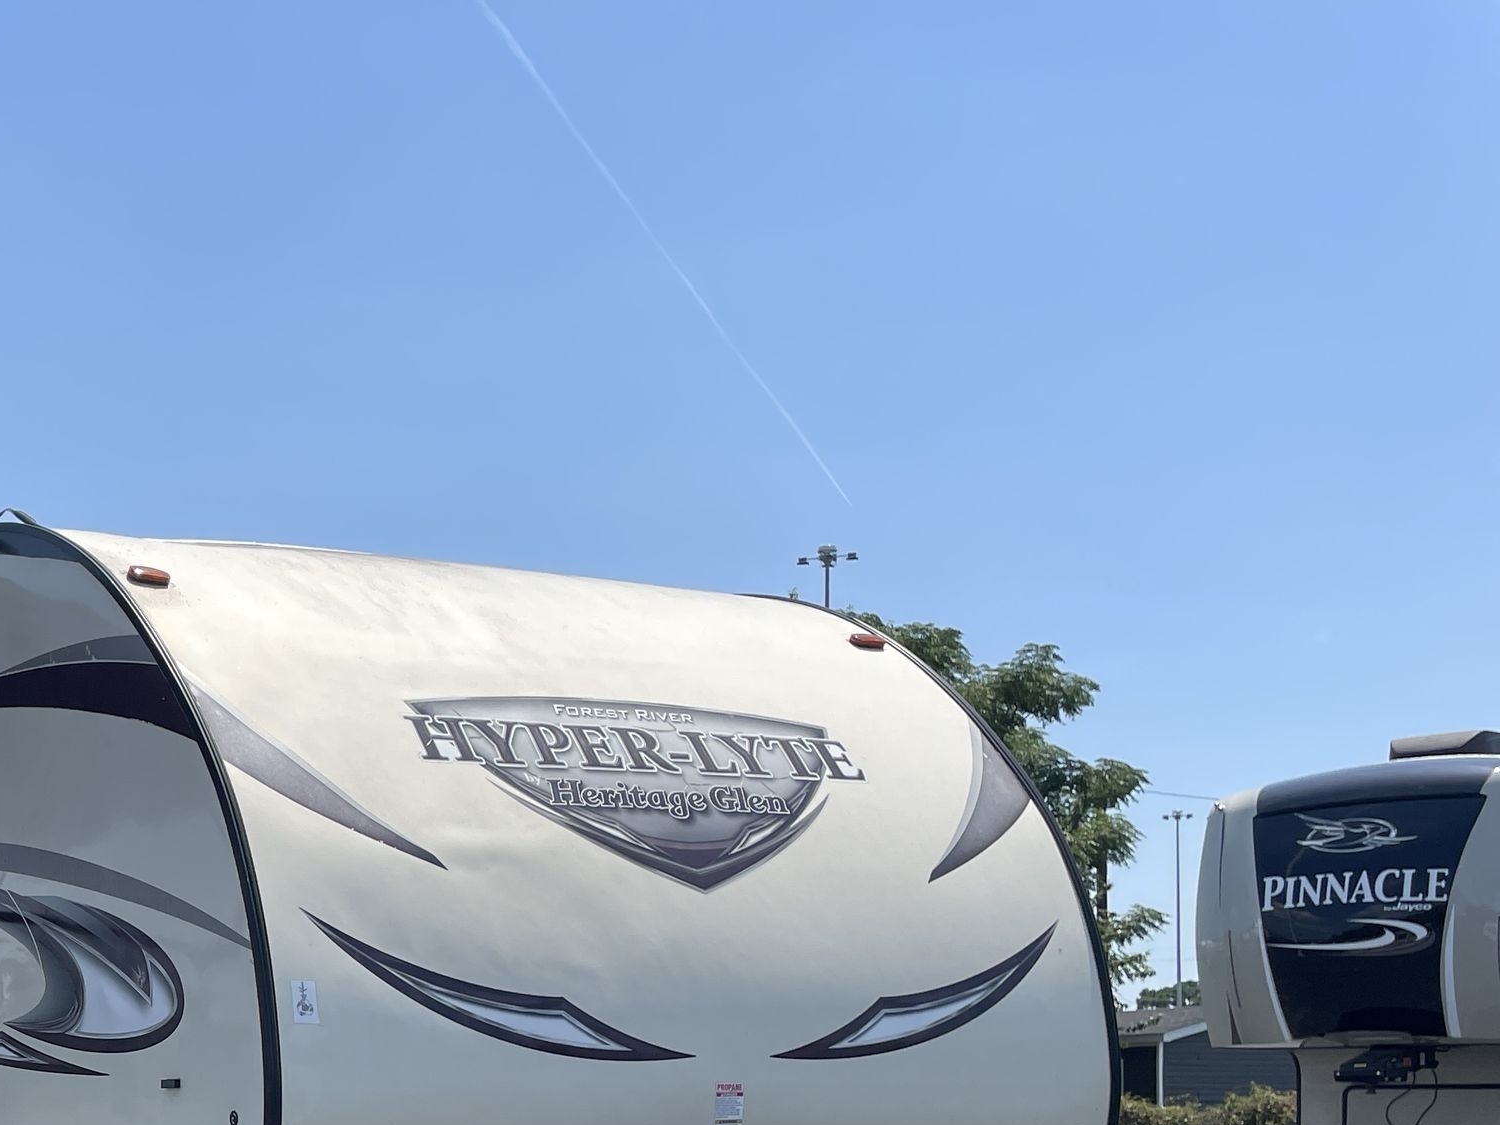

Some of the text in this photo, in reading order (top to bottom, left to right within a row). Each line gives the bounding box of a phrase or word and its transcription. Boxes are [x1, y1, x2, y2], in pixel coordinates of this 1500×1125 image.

[553, 704, 693, 723] FOREST RIVER
[403, 714, 867, 783] HYPER-LYTE
[524, 772, 791, 819] by Heritage Glen
[1262, 868, 1449, 912] PINNACLE
[1392, 902, 1432, 912] Jayco
[717, 1083, 742, 1092] PROPANE
